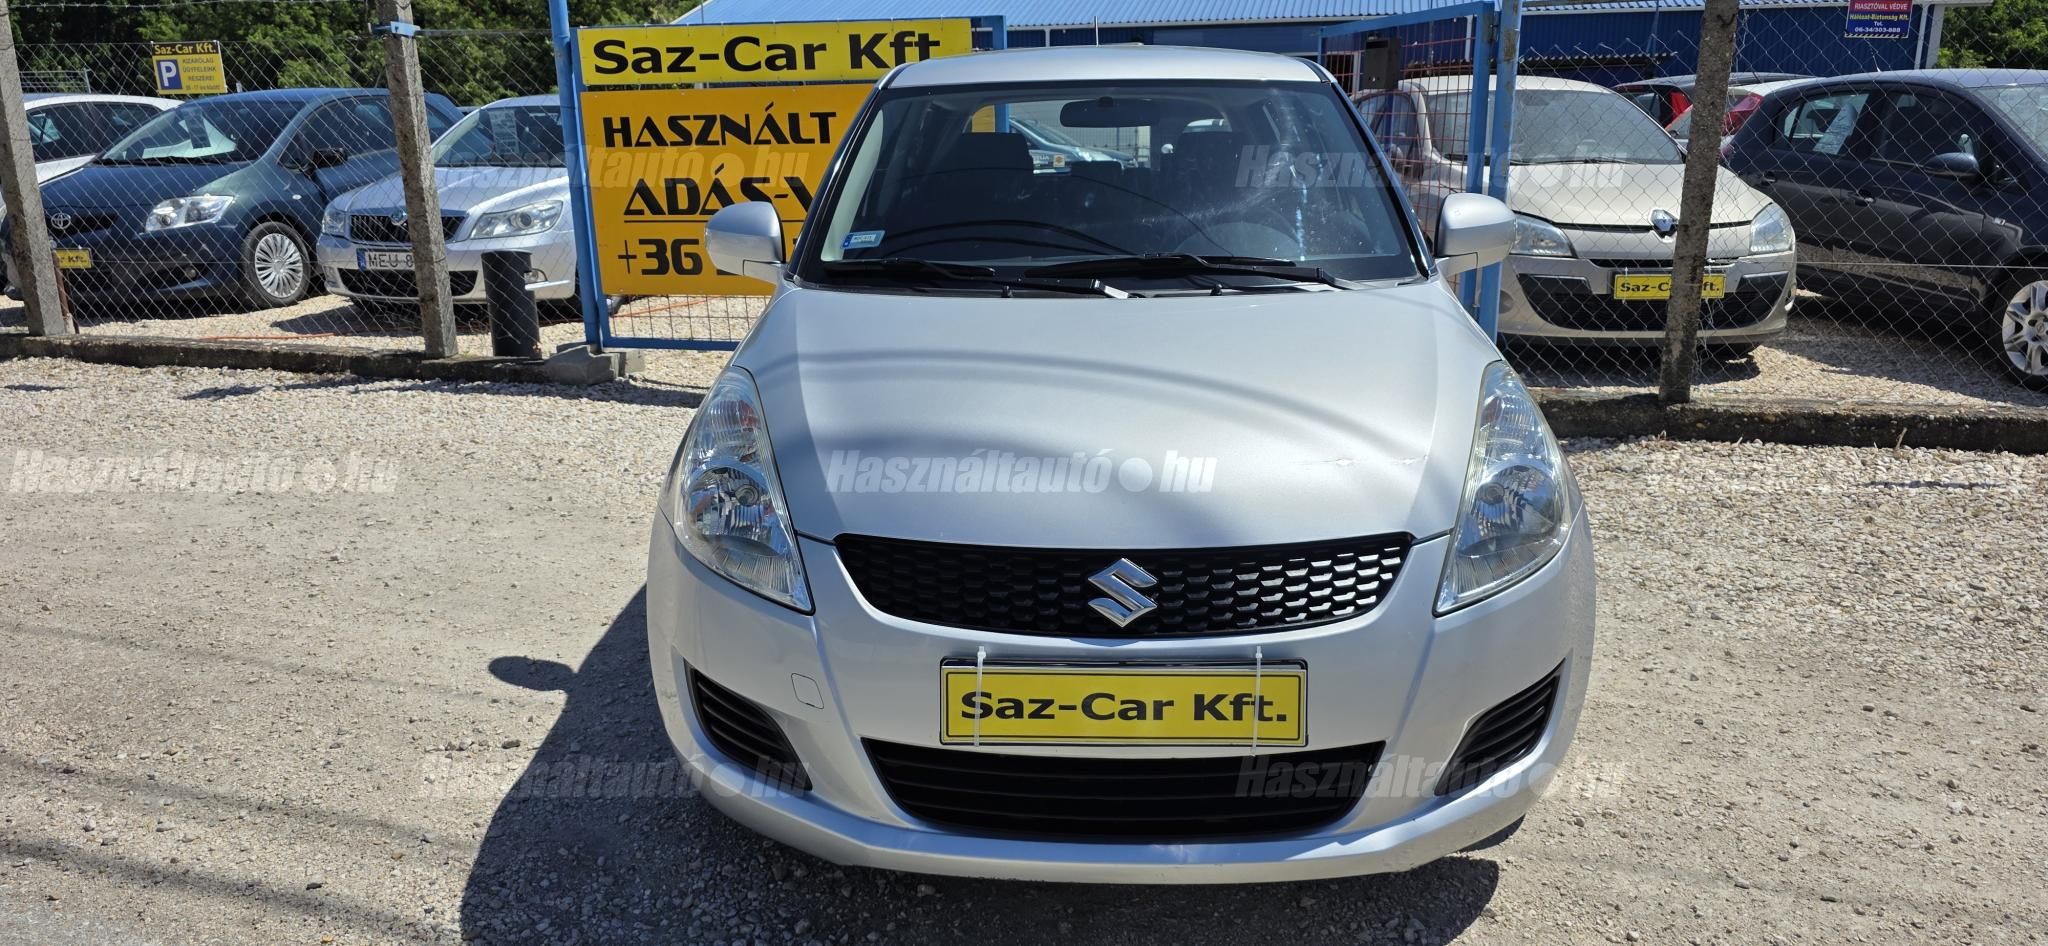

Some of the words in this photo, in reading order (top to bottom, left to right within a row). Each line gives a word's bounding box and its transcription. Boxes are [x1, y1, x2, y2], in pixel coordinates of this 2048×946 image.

[154, 44, 194, 55] Saz-Car
[195, 42, 217, 54] Kft.
[593, 36, 827, 75] Saz-Car
[160, 61, 177, 87] P
[602, 101, 837, 148] HASZNÁLT
[617, 238, 704, 276] +36
[1702, 281, 1720, 292] ft.
[960, 691, 1174, 721] Saz-Car
[1193, 692, 1288, 723] Kft.
